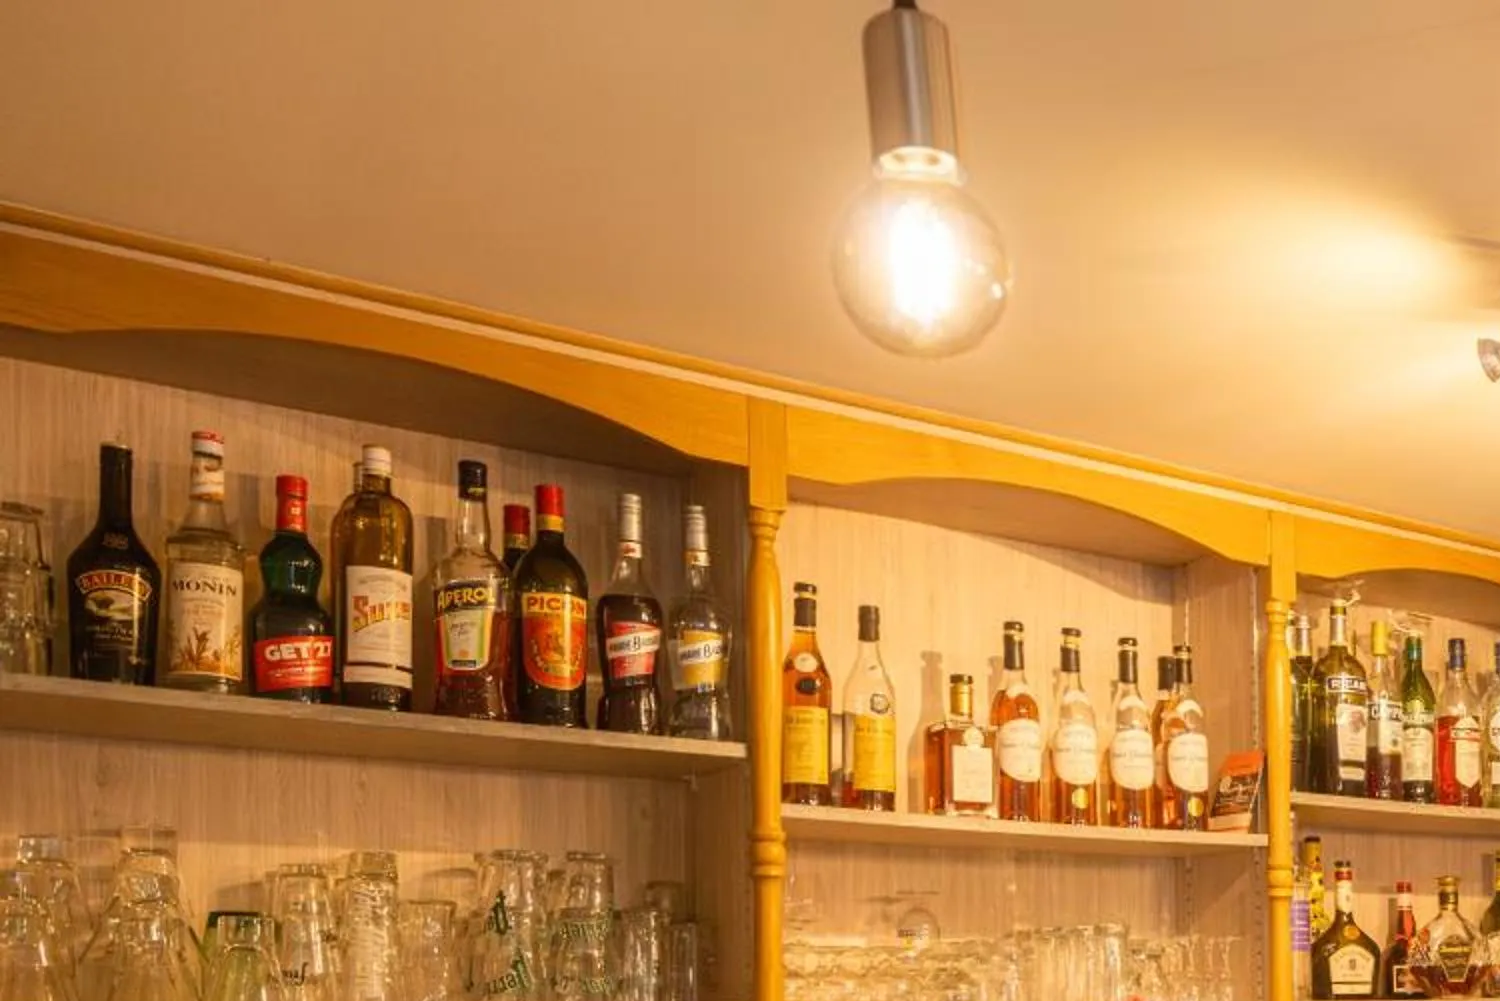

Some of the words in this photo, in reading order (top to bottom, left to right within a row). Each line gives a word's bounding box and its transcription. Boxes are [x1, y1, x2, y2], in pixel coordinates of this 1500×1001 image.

[172, 578, 238, 597] MONIN
[438, 586, 495, 610] APEROL
[527, 596, 585, 616] PICN
[264, 642, 310, 661] GET
